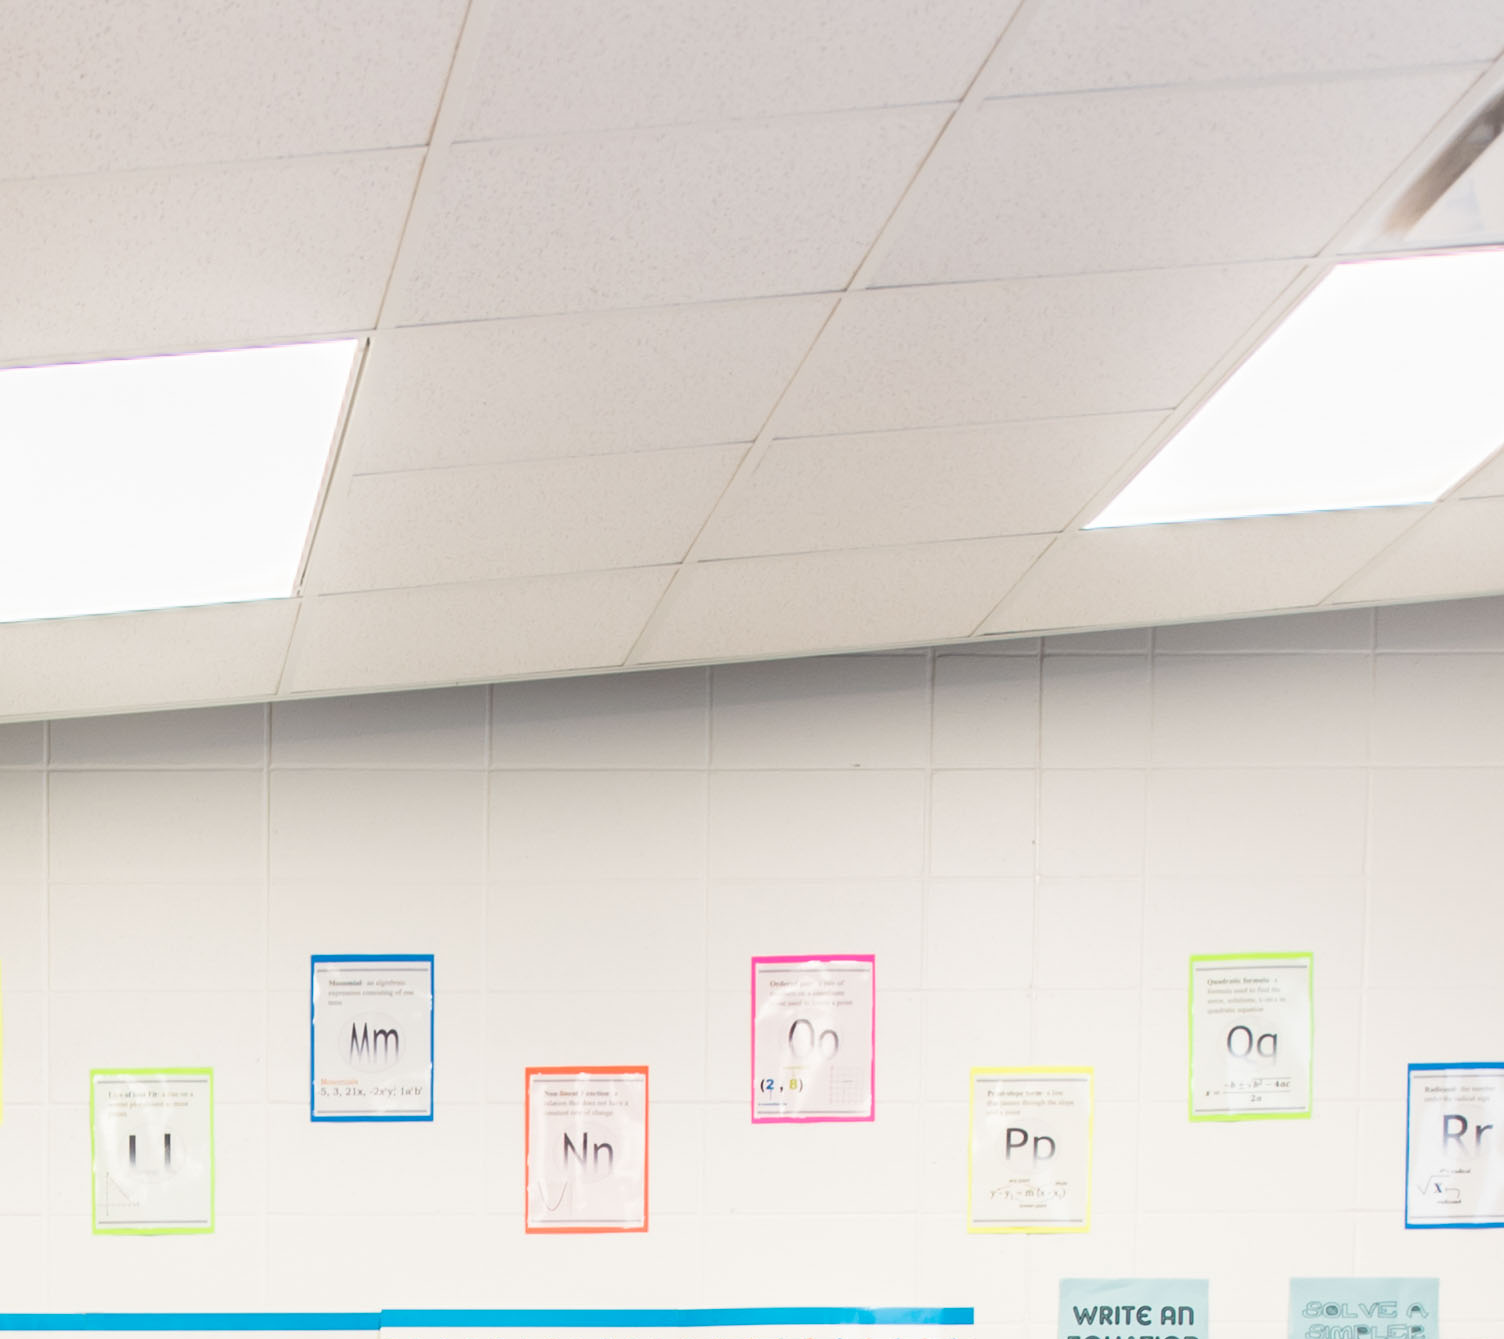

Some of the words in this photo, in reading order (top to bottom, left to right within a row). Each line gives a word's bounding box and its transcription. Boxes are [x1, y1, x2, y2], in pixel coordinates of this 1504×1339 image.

[349, 1021, 399, 1064] Mm
[563, 1131, 614, 1174] Nn
[1004, 1126, 1057, 1167] Pp
[1441, 1113, 1494, 1155] Rr
[1073, 1305, 1152, 1326] WRITE
[1161, 1305, 1195, 1326] AN
[1302, 1300, 1397, 1319] SOLVE
